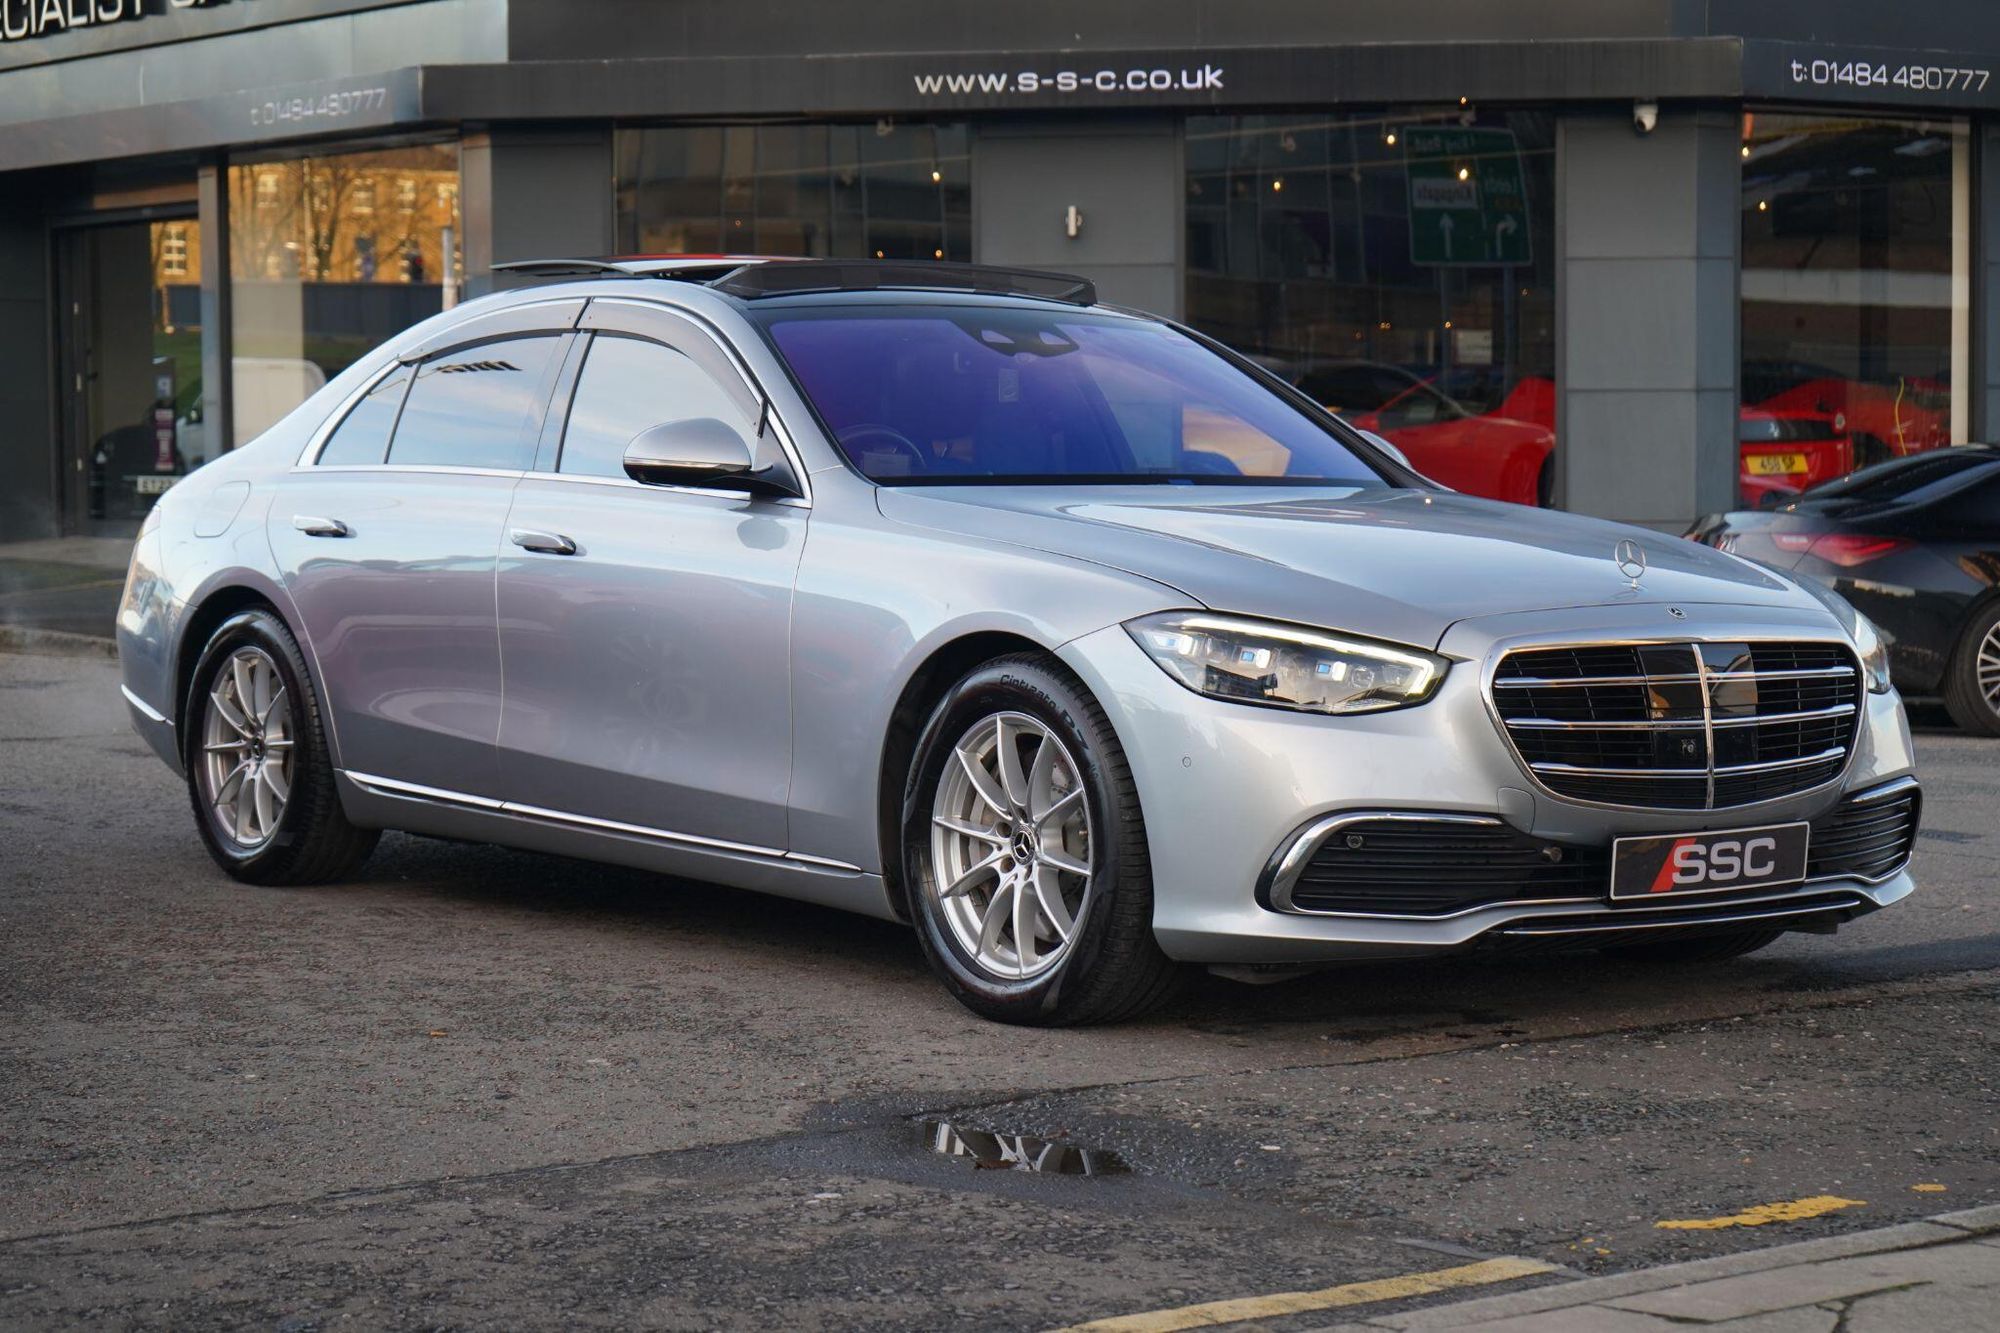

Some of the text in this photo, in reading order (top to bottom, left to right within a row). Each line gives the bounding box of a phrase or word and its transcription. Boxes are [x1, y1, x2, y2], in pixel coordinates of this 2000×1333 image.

[914, 64, 1225, 94] www.s-s-c.co.uk
[1812, 59, 1889, 87] 01484
[1893, 65, 1990, 92] 480777
[1671, 837, 1776, 884] SSC
